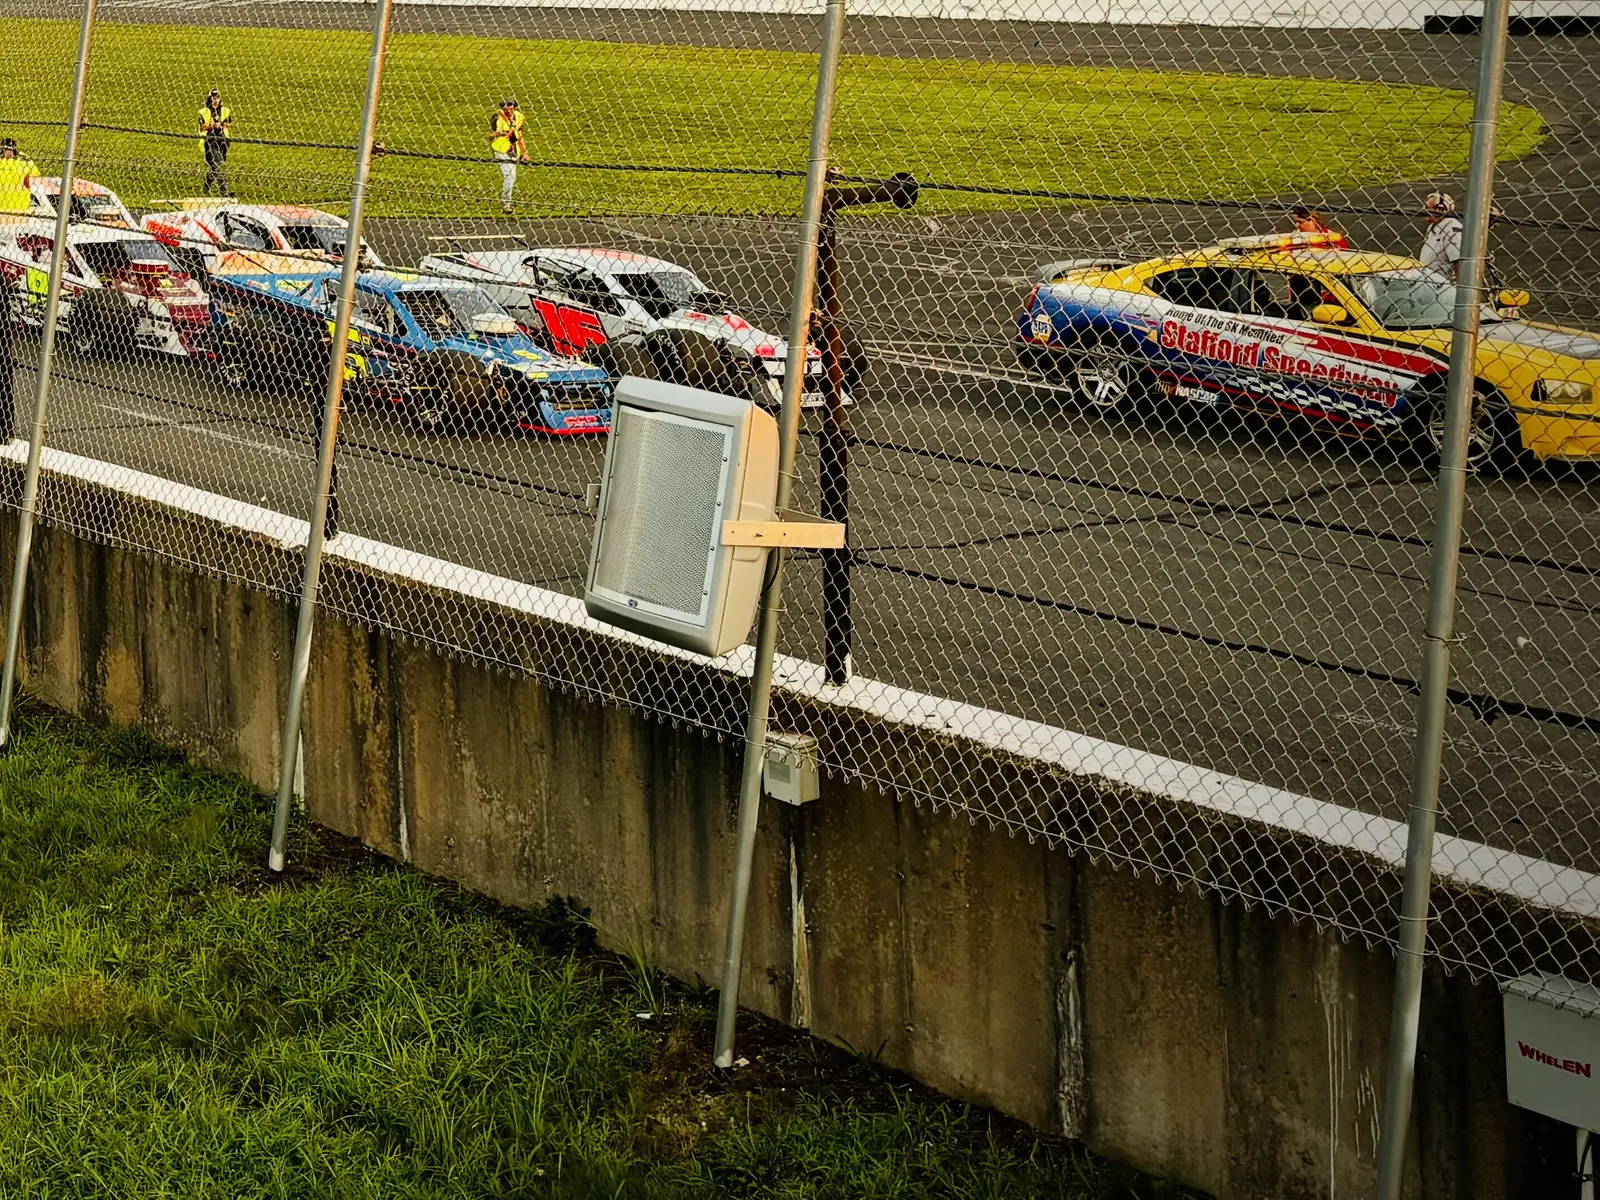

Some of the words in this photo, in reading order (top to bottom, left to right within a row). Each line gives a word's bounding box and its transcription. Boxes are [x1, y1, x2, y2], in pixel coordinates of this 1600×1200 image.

[1166, 309, 1193, 321] Home
[1207, 315, 1223, 329] The
[1225, 321, 1239, 333] SK
[1160, 319, 1260, 367] Stafford
[1261, 345, 1400, 408] Speedway
[1175, 386, 1218, 404] NASCAR
[1517, 1039, 1592, 1079] WHELEN
